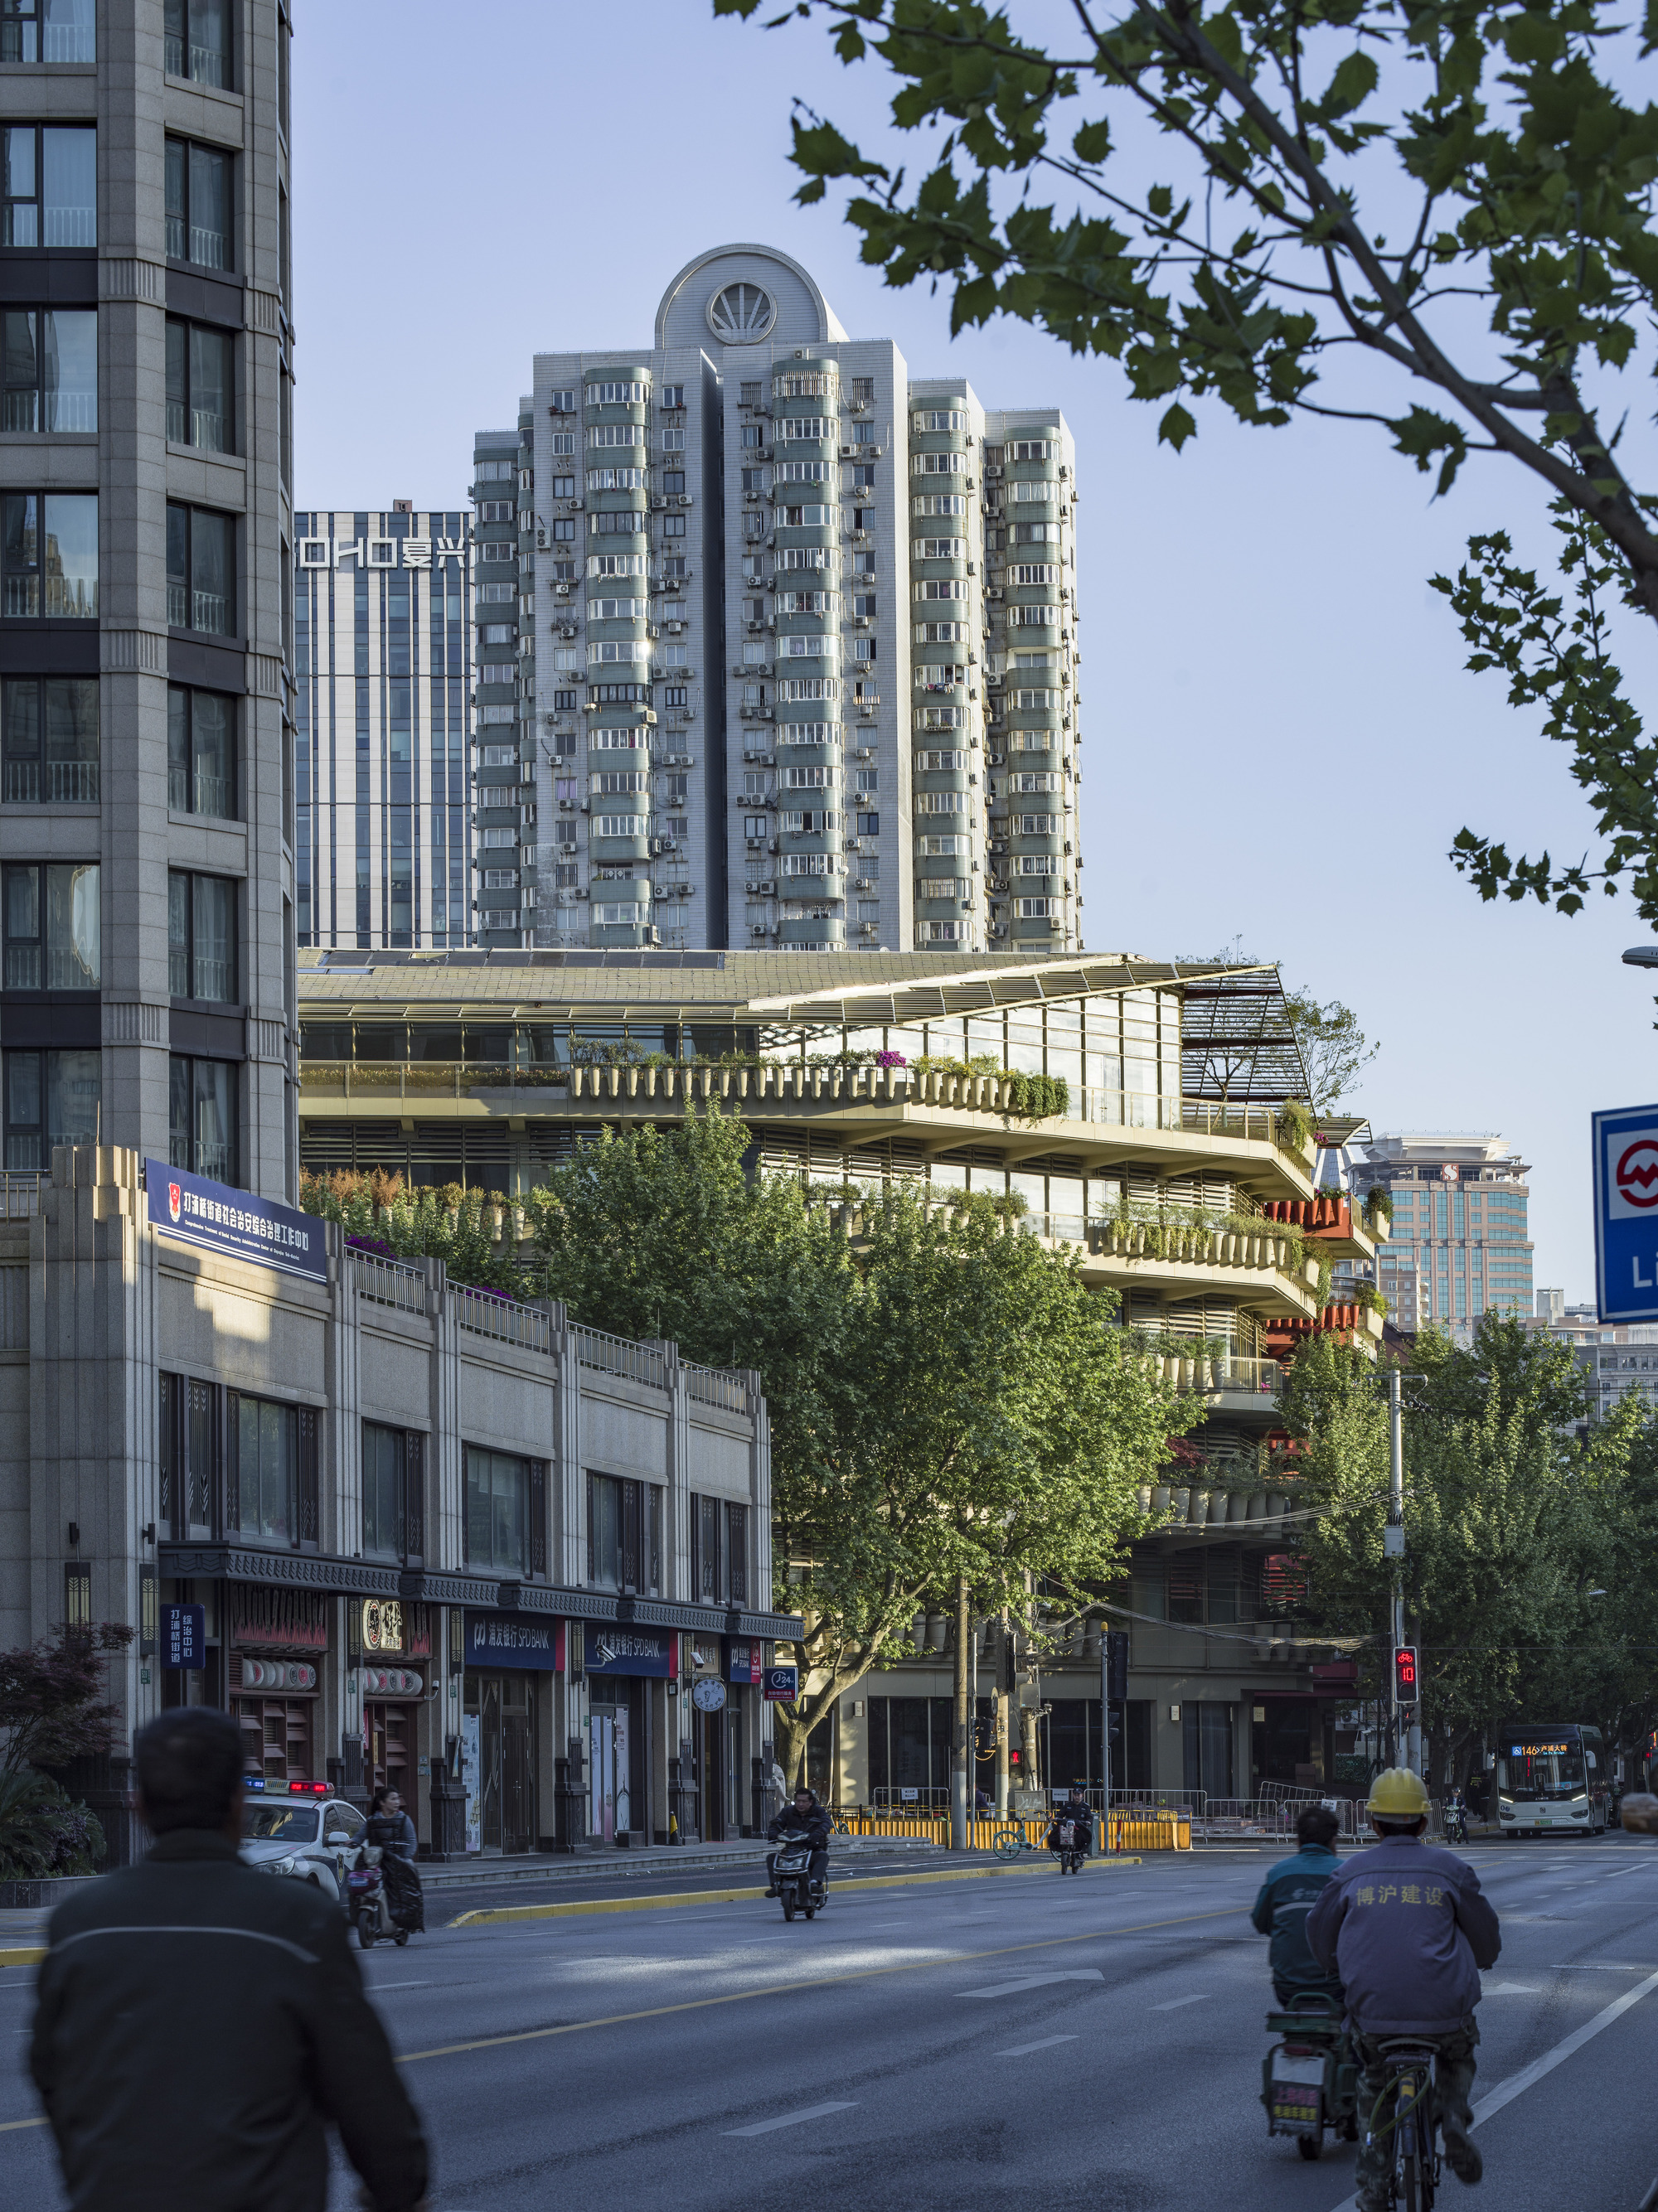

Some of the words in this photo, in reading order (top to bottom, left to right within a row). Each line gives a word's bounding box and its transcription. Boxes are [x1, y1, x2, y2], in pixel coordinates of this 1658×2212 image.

[170, 1609, 181, 1663] 打浦桥街道
[182, 1614, 193, 1658] 综治中心
[488, 1620, 517, 1648] 浦发银行
[518, 1627, 531, 1648] SPD
[531, 1629, 550, 1649] BANK
[608, 1631, 633, 1657] 浦发银行
[633, 1637, 644, 1656] SPD
[644, 1638, 660, 1658] BANK
[1403, 1667, 1413, 1681] 10
[1522, 1746, 1537, 1756] 146
[1355, 1884, 1444, 1907] 博沪建设
